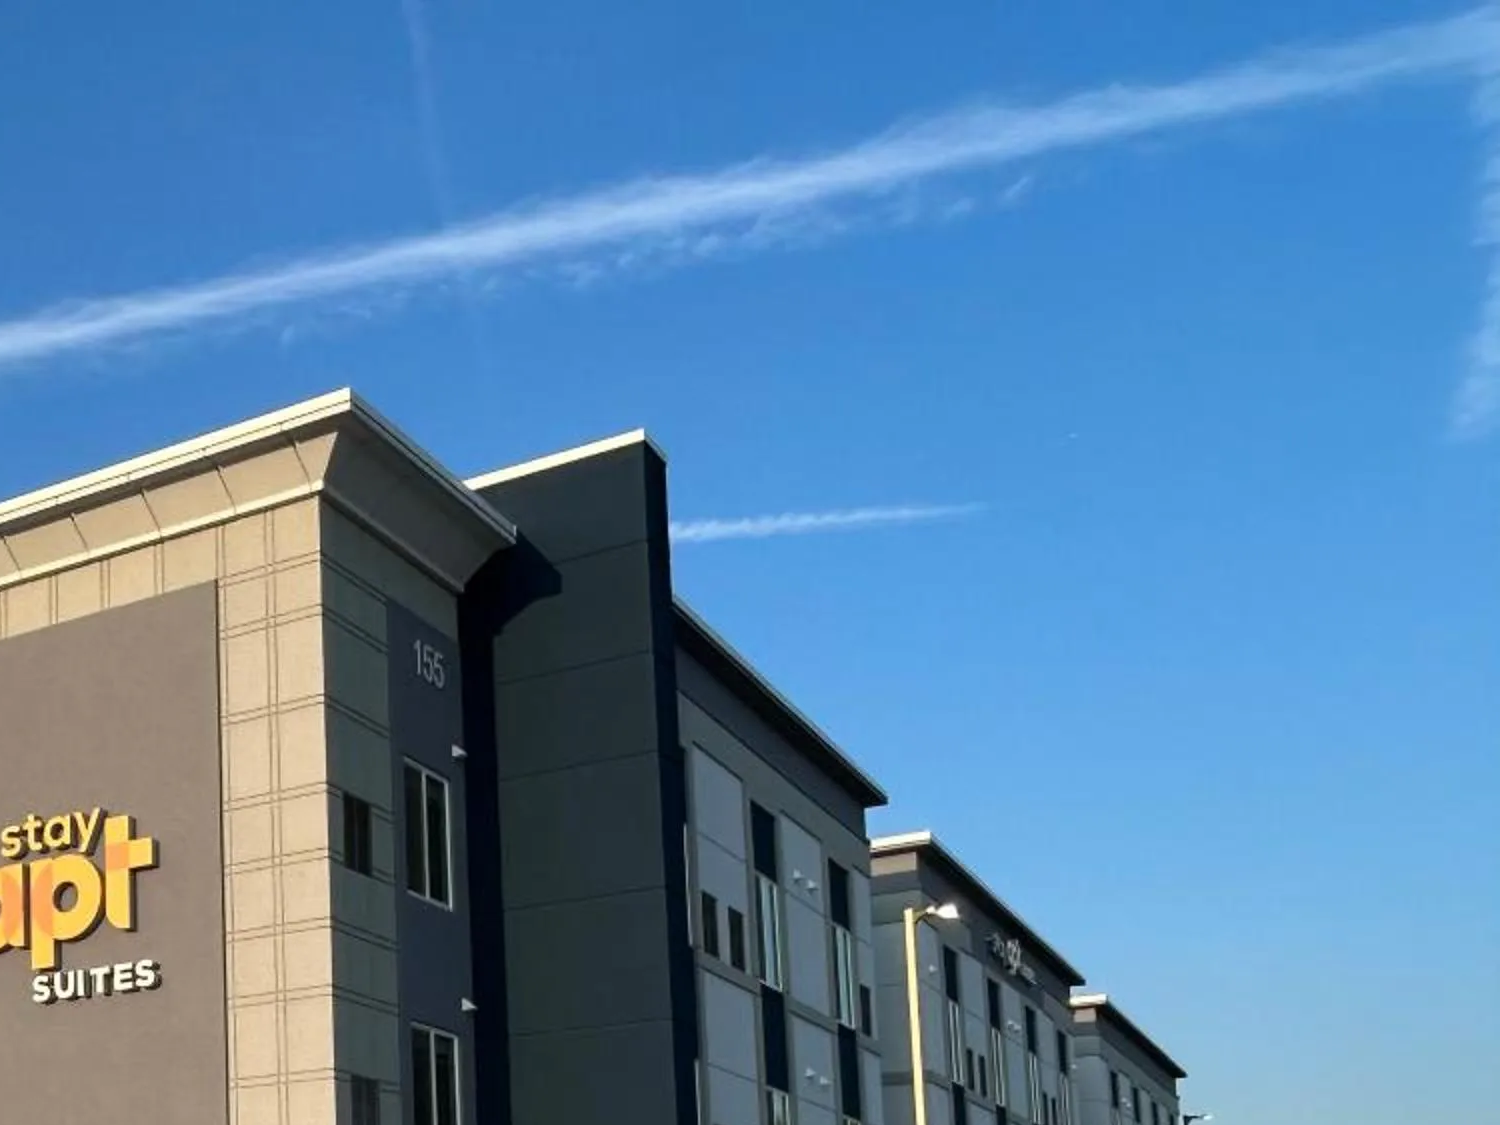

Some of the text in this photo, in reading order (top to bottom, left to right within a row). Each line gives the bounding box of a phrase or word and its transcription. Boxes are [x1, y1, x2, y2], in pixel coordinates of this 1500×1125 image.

[413, 639, 445, 689] 155
[0, 806, 104, 858] stay
[32, 958, 158, 1003] SUITES
